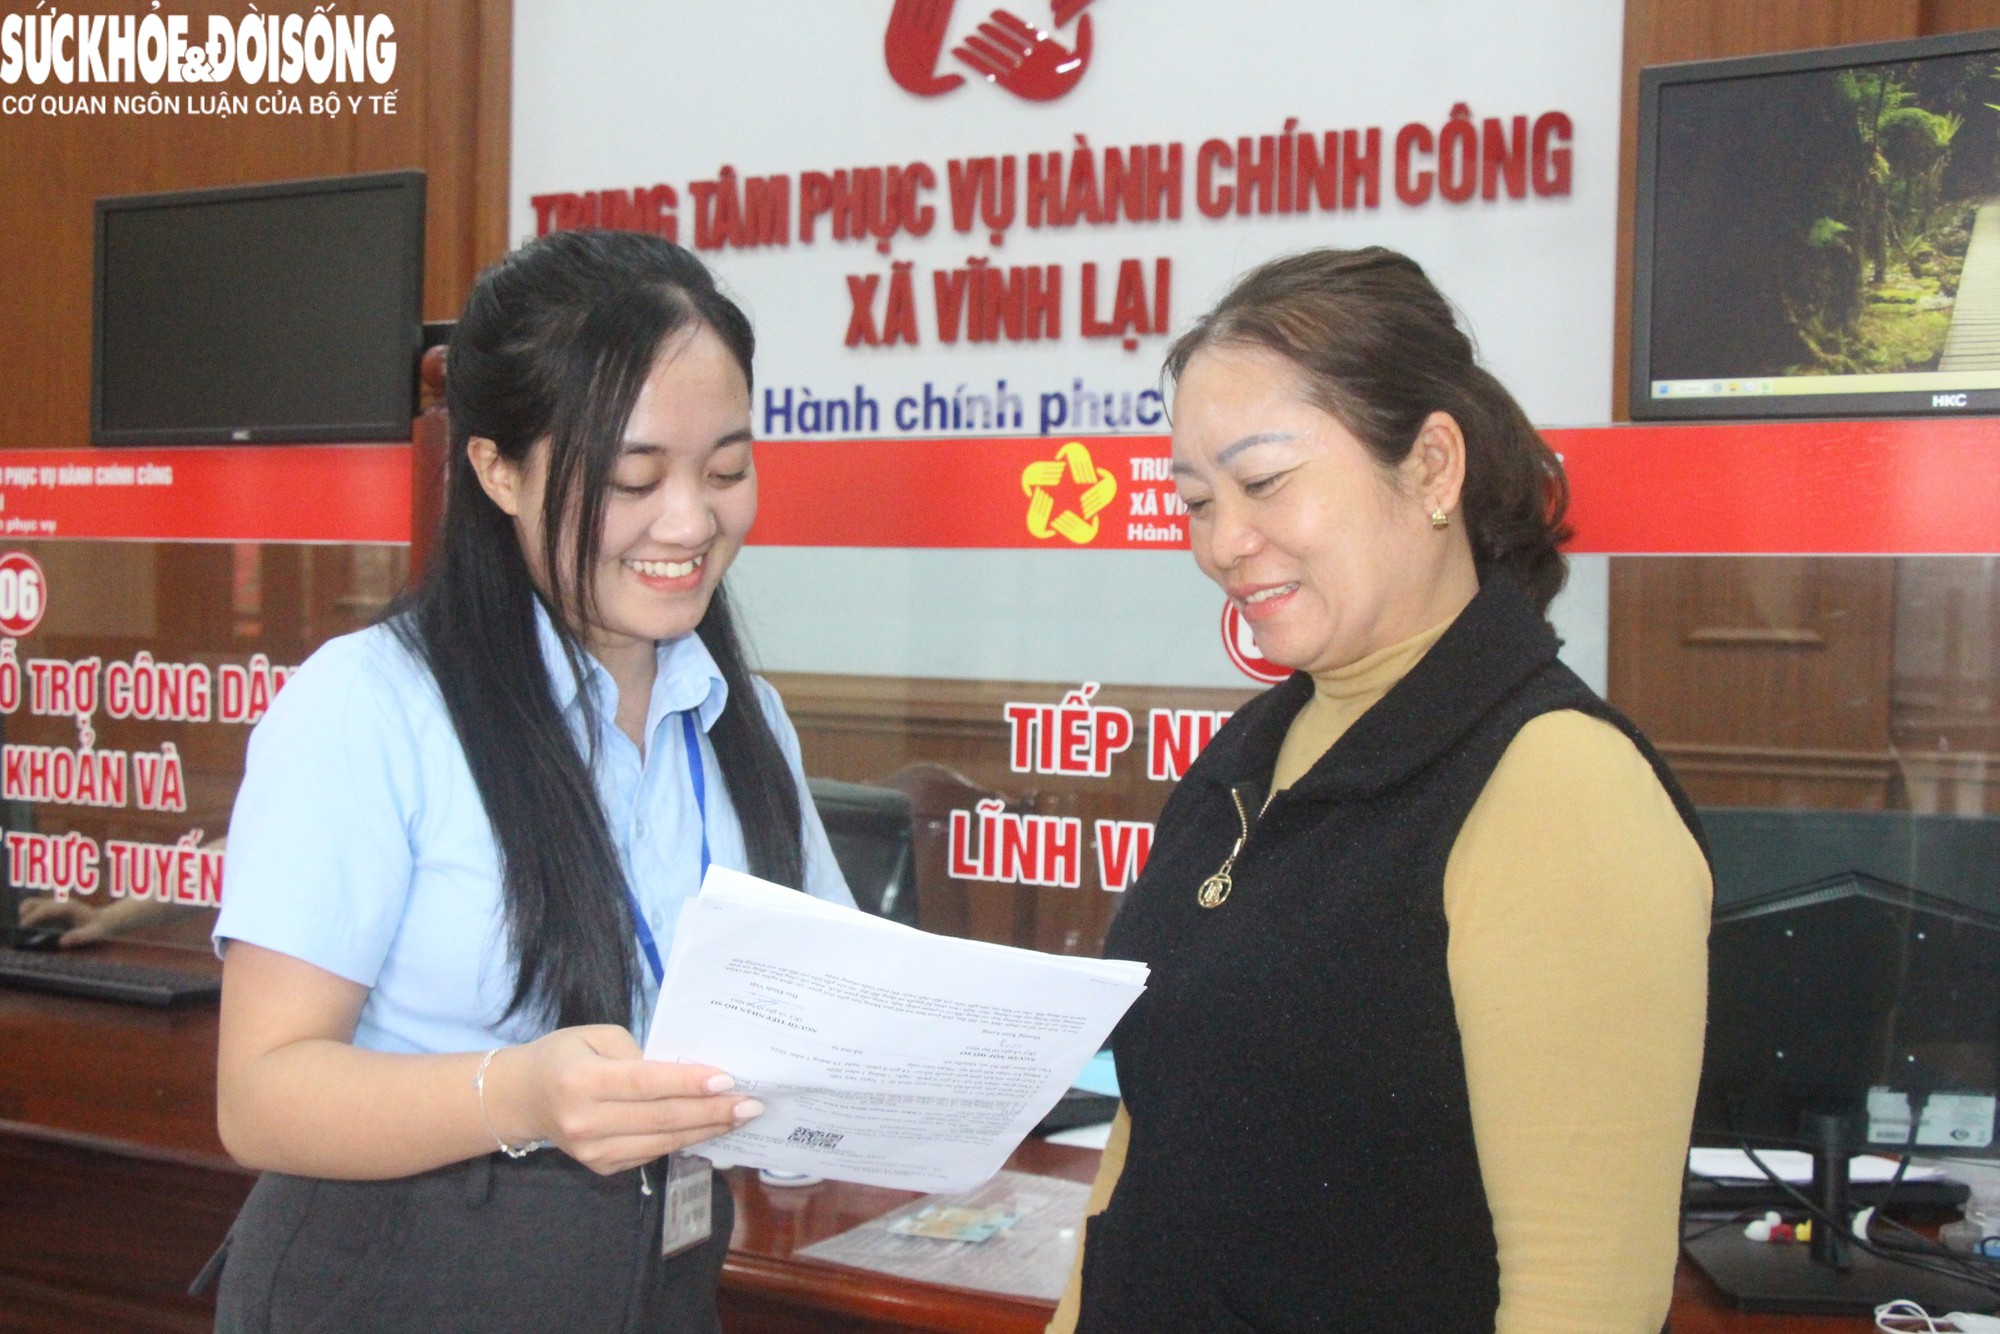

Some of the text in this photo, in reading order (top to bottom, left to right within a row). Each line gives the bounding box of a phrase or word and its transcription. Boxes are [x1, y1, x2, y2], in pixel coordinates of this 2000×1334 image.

[688, 165, 790, 250] TÂM
[800, 162, 936, 254] PHỤC
[947, 155, 1016, 246] VỤ
[1027, 135, 1182, 229] HÀNH
[1197, 117, 1381, 218] CHÍNH
[1395, 102, 1573, 207] CÔNG
[845, 257, 1170, 351] XÃ VĨNH LẠI
[764, 385, 878, 434] Hành
[895, 381, 1023, 430] chính
[1932, 394, 1967, 408] HKC
[1129, 457, 1173, 481] TRU
[1129, 488, 1158, 516] XÃ
[1127, 523, 1183, 542] Hành
[0, 568, 39, 620] 06
[27, 656, 101, 728] TRỢ
[105, 651, 210, 722] CÔNG
[1003, 681, 1134, 777] TIẾP
[2, 727, 187, 812] KHOẢN VÀ
[6, 828, 224, 907] TRỰC TUYẾN
[949, 798, 1082, 888] LĨNH
